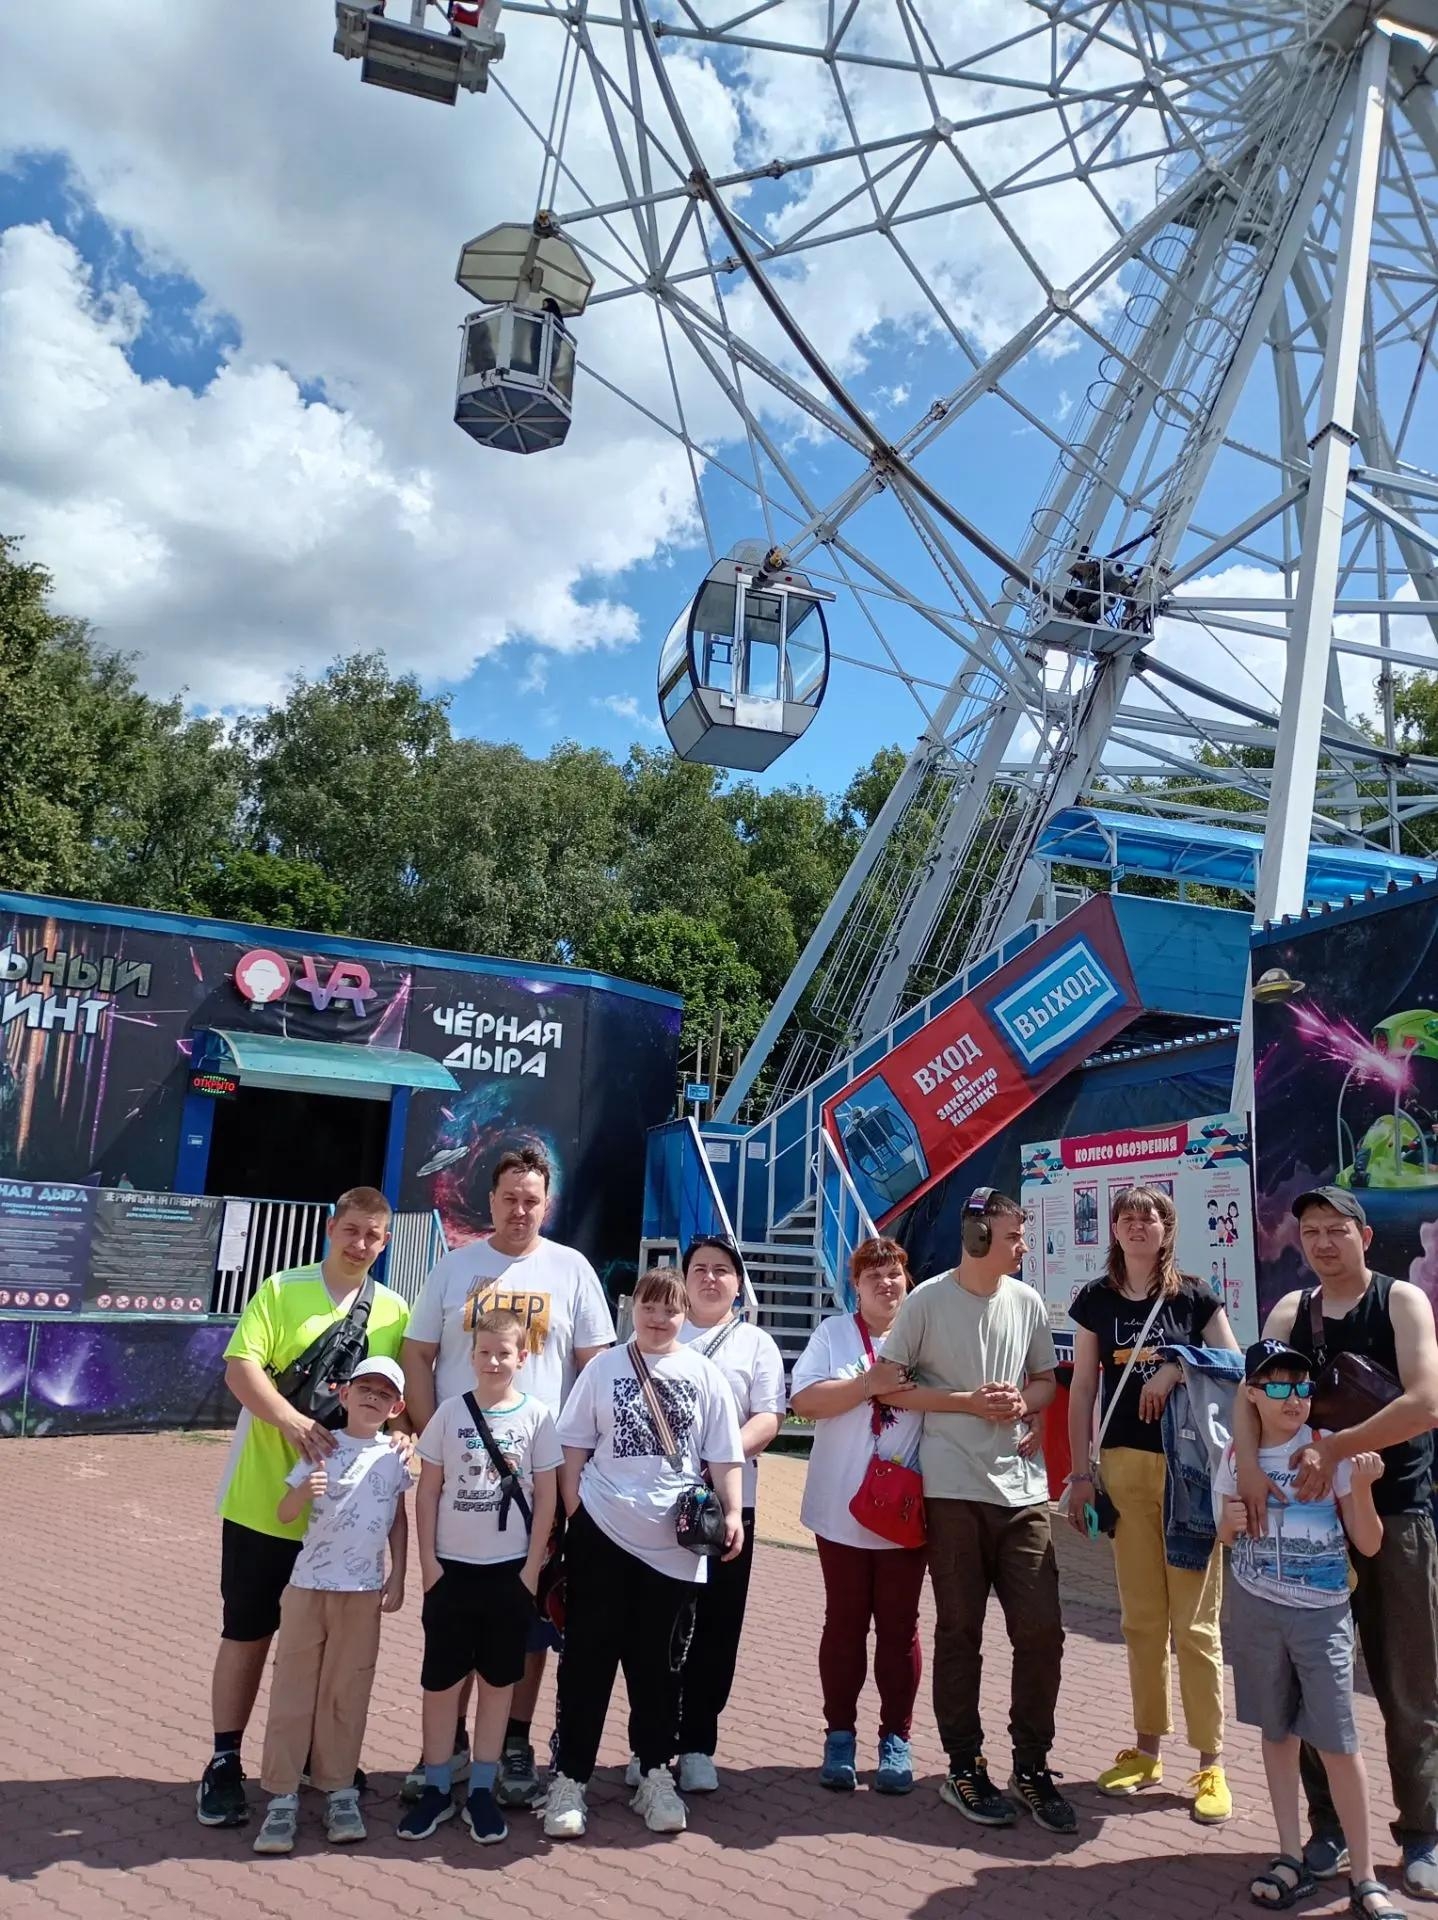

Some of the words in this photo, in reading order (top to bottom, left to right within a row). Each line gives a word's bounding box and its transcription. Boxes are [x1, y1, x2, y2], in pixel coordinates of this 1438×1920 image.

[297, 955, 377, 1018] VR
[1013, 965, 1101, 1040] ВЫХОД
[2, 990, 110, 1034] ИНТ
[433, 1001, 563, 1048] ЧЁРНАЯ
[443, 1042, 547, 1078] ДЫРА
[912, 1033, 983, 1095] ВХОД
[193, 1078, 235, 1091] ОТКРЫТО
[936, 1067, 998, 1120] ЗАКРЫТУЮ
[949, 1082, 998, 1126] КАБИНКУ
[951, 1075, 969, 1092] НА
[1075, 1145, 1113, 1163] КОЛЕСО
[1115, 1136, 1177, 1158] ОБОЗРЕНИЯ
[38, 1187, 88, 1202] ДЫРА
[457, 1489, 496, 1500] SLEEP
